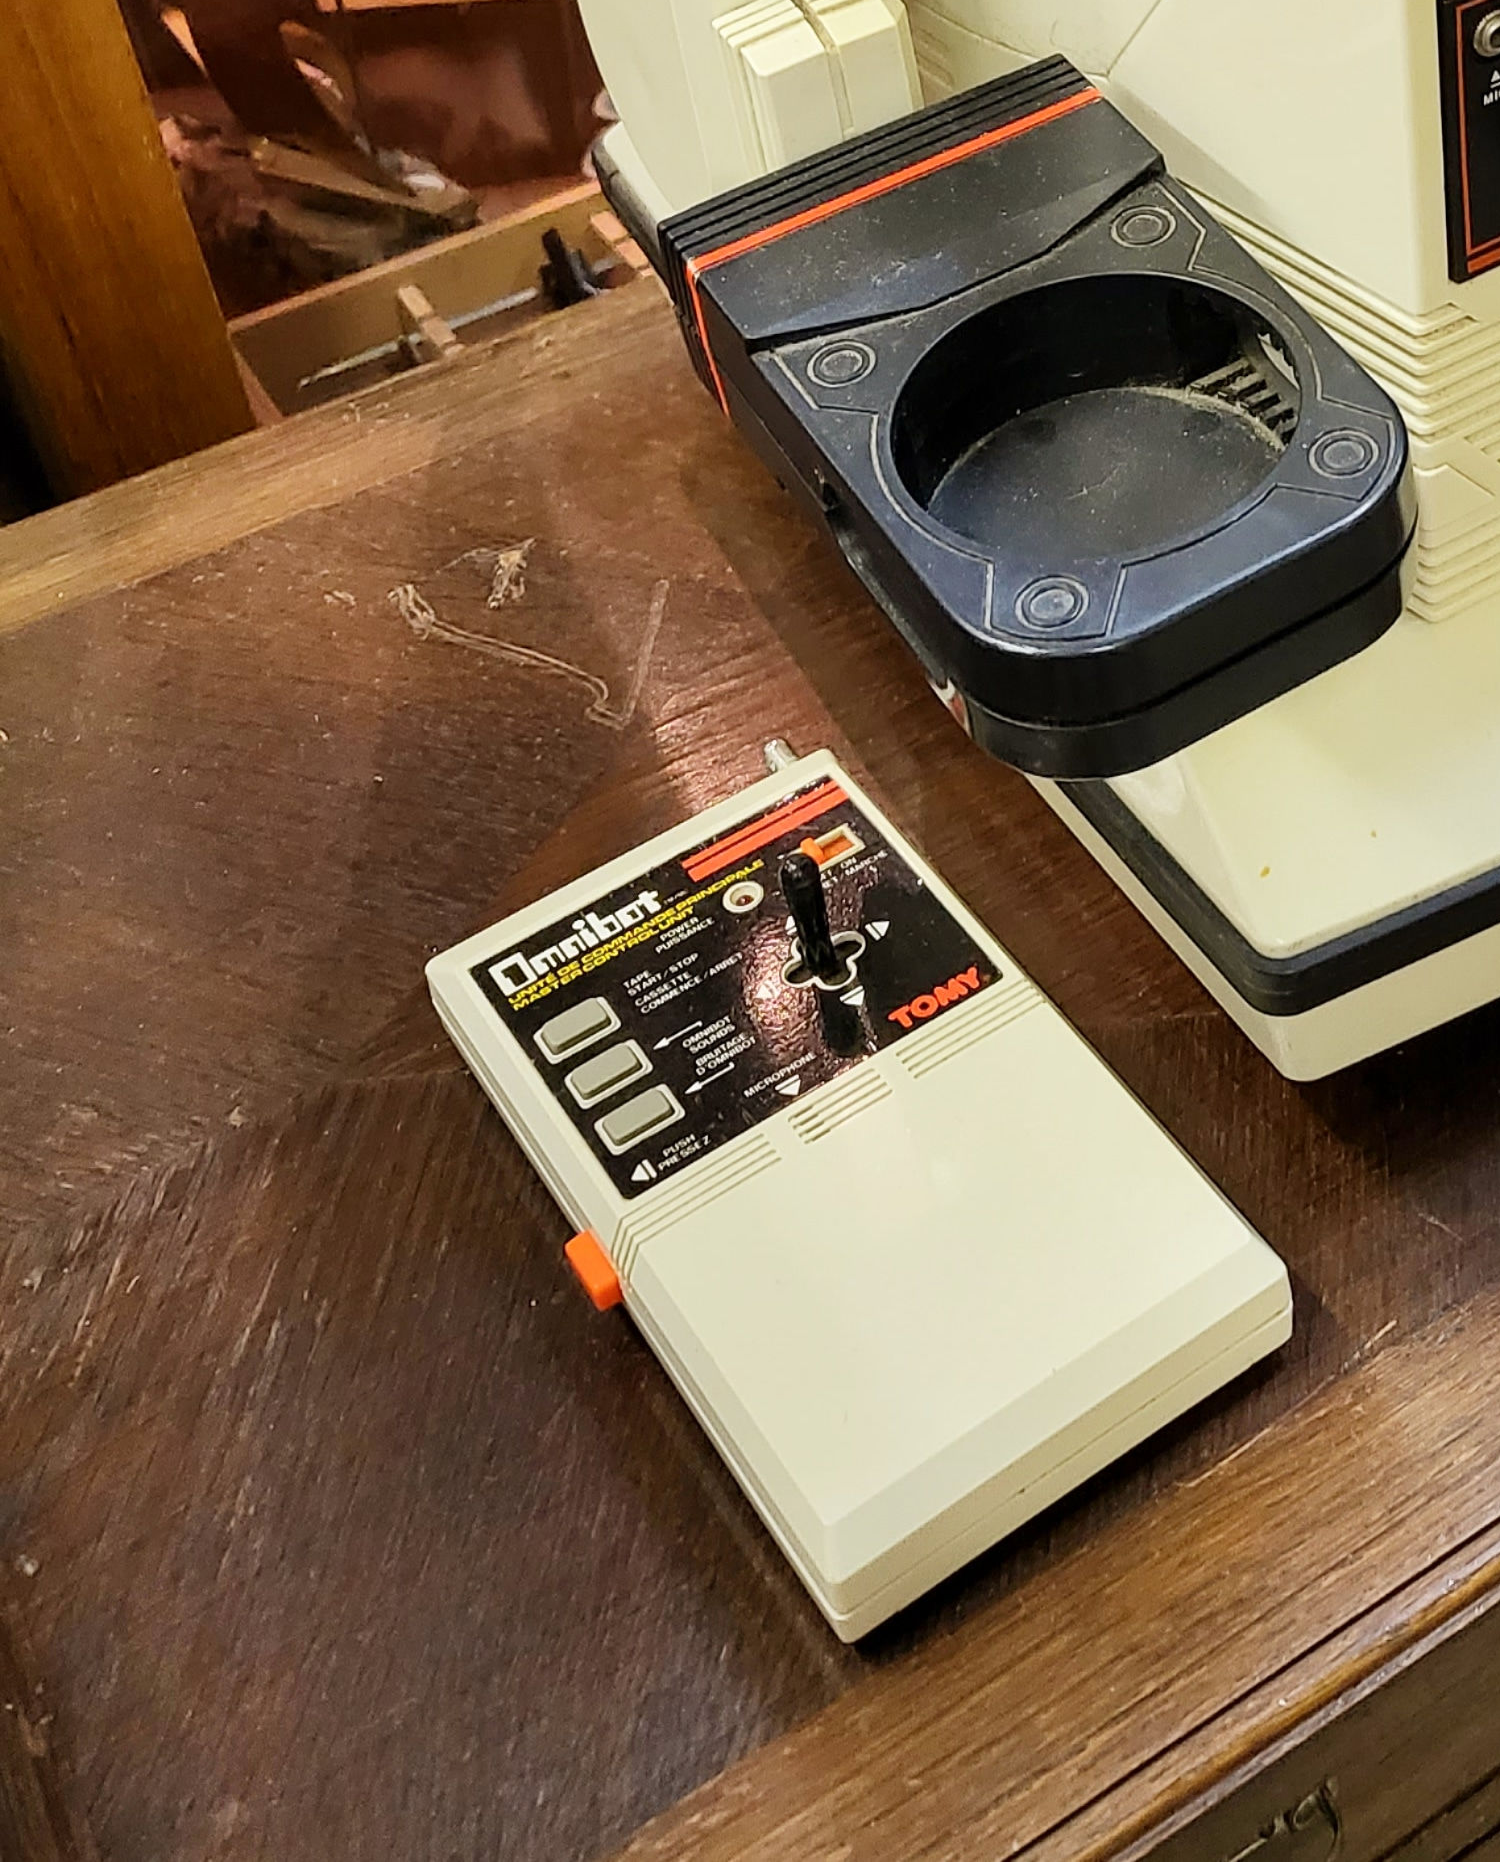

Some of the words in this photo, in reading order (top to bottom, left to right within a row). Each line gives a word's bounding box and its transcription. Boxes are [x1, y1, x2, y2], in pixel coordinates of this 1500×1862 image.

[556, 960, 580, 976] DE
[581, 907, 677, 964] COMMANDE
[675, 859, 764, 911] PRINCIPALE
[655, 917, 715, 954] PUISSANCE
[659, 916, 699, 942] POWER
[488, 890, 662, 997] Omnibot
[513, 969, 583, 1011] MASTER
[582, 929, 660, 972] CONTROL
[659, 905, 694, 931] UNIT
[623, 969, 652, 989] TAPE
[635, 971, 692, 1007] CASSETTE
[888, 966, 980, 1029] TOMY
[682, 1015, 732, 1049] OMNIBOT
[689, 1023, 736, 1055] SOUNDS
[695, 1033, 748, 1068] BRUITAGE
[743, 1052, 817, 1099] MICROPHONE
[662, 1133, 696, 1158] PUSH
